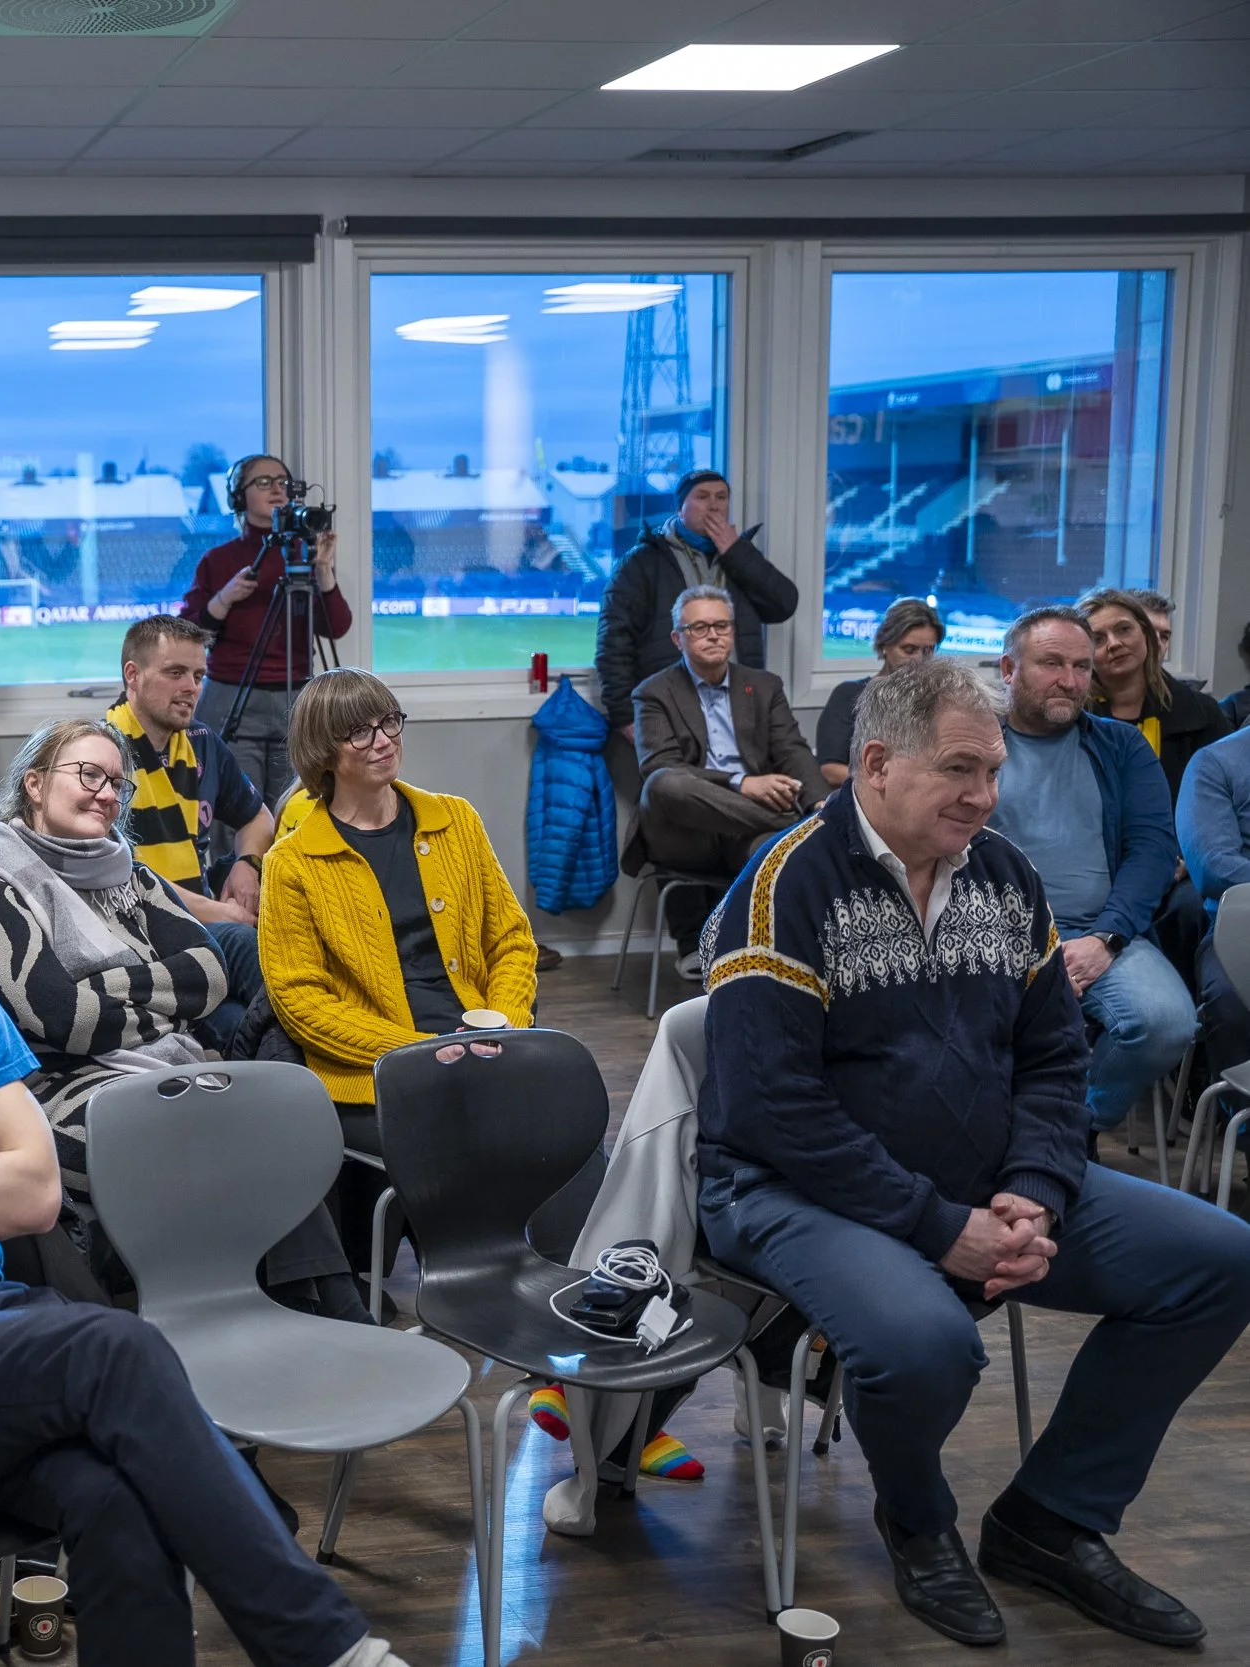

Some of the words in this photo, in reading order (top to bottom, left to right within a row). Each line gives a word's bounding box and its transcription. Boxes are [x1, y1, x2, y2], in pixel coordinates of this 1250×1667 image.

[36, 605, 90, 625] QATAR
[93, 602, 159, 622] AIRWAYS
[500, 599, 549, 614] PS5
